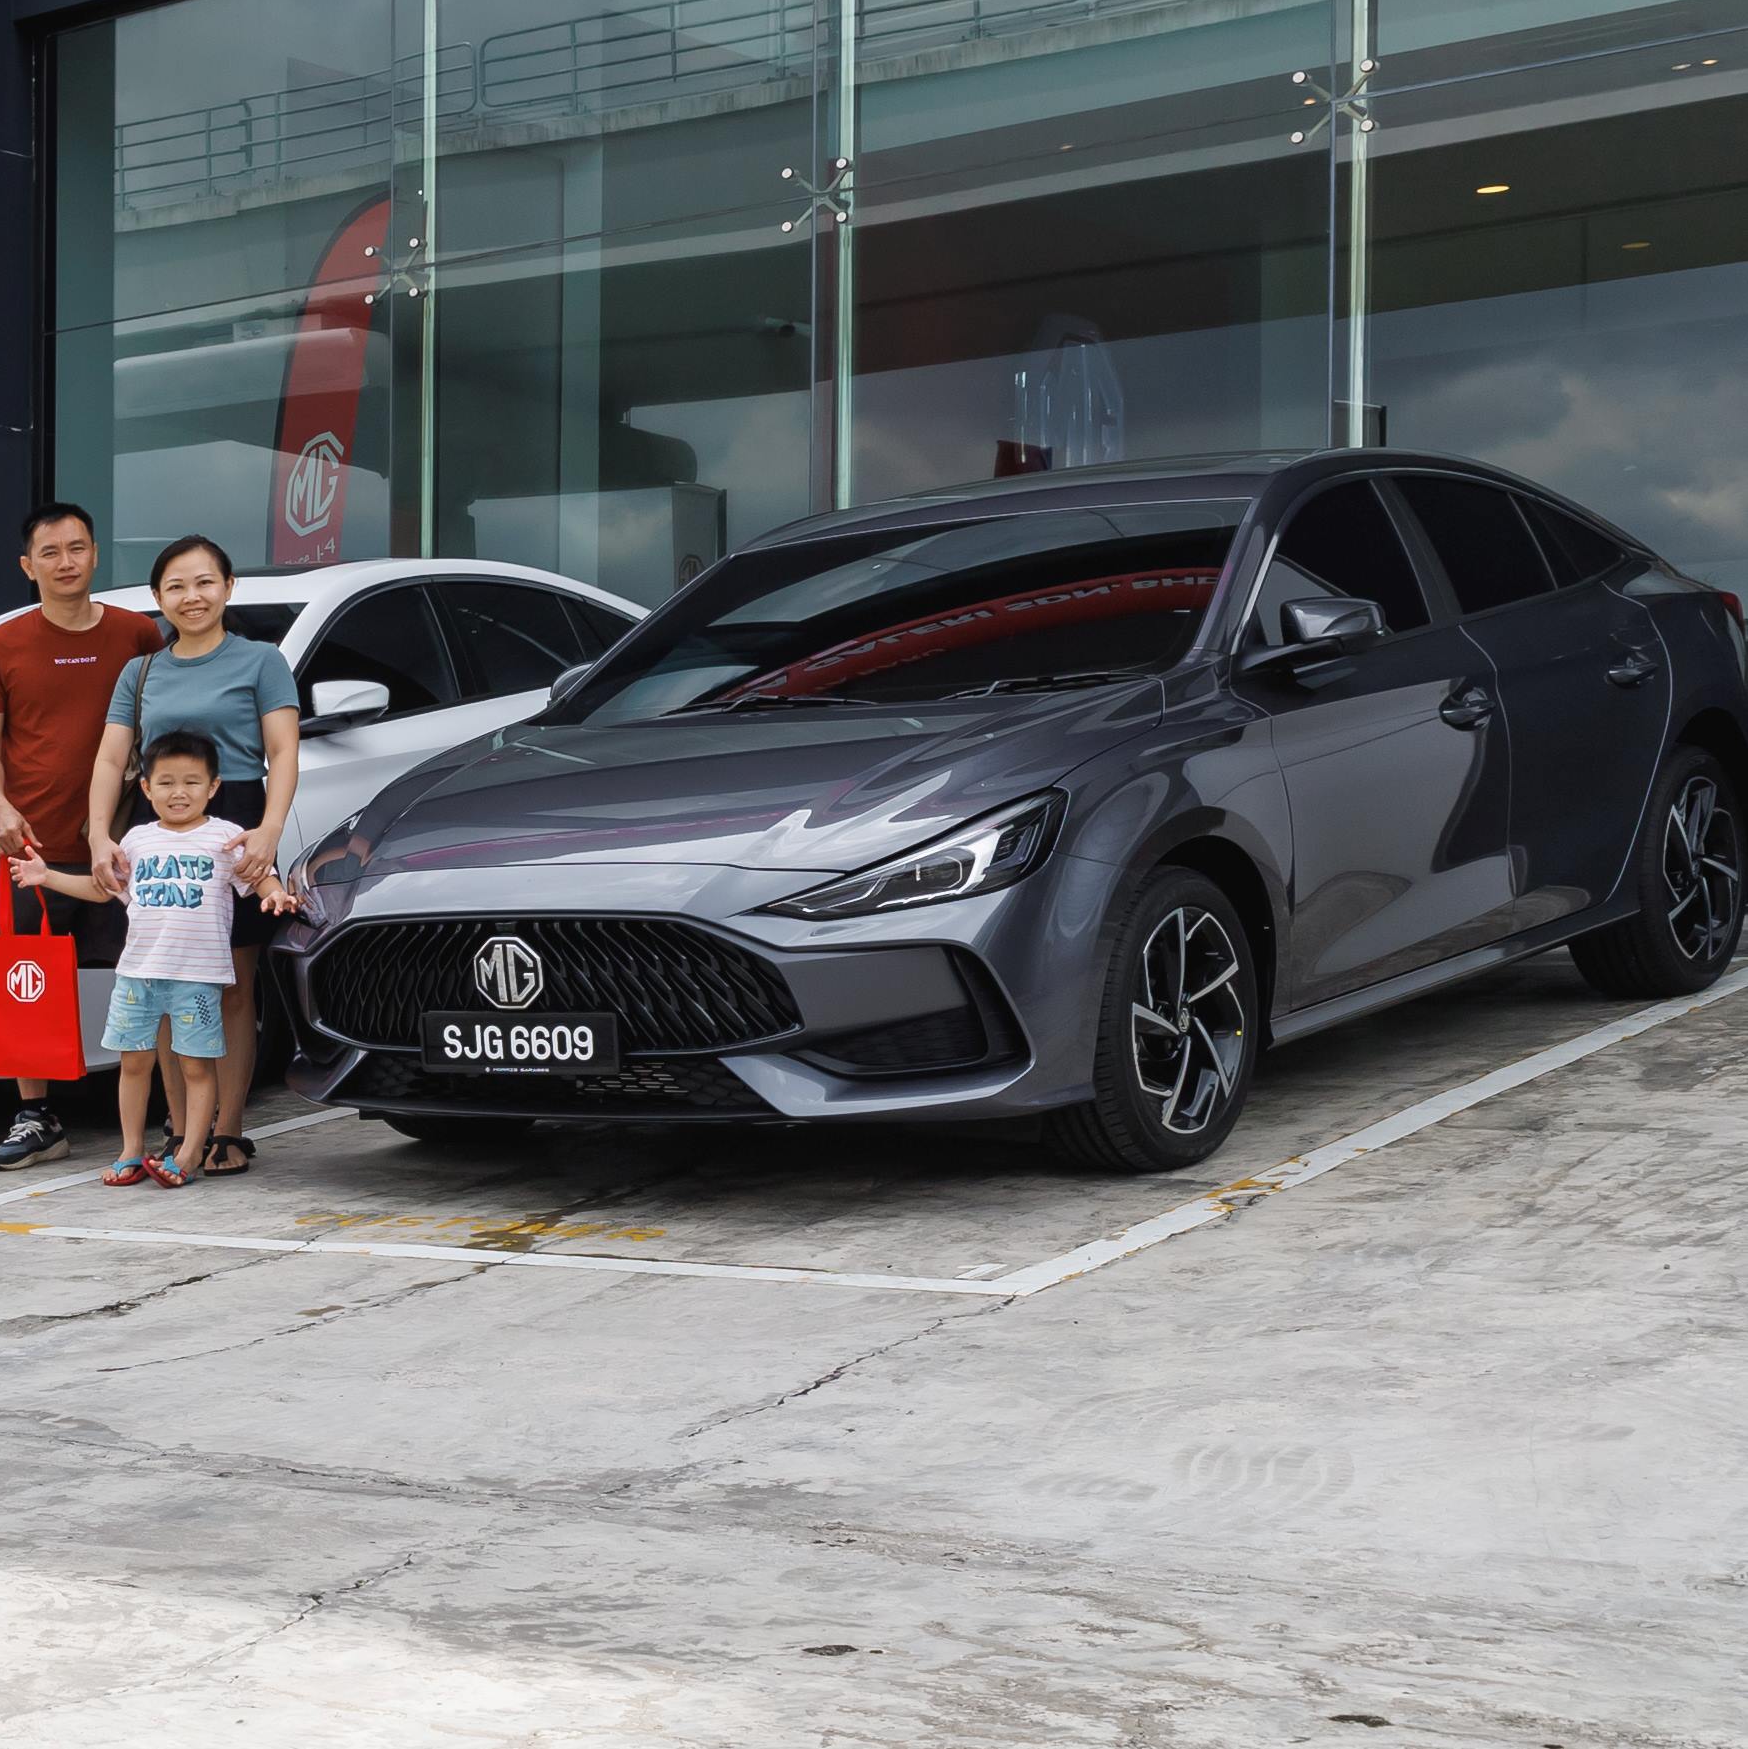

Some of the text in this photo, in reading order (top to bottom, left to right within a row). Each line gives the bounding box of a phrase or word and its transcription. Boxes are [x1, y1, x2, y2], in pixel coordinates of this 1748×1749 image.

[291, 442, 340, 524] MG
[135, 854, 215, 883] SKATE
[135, 881, 204, 909] TIME
[10, 963, 42, 999] MG
[478, 943, 536, 1003] MG
[443, 1024, 594, 1061] SJG 6609
